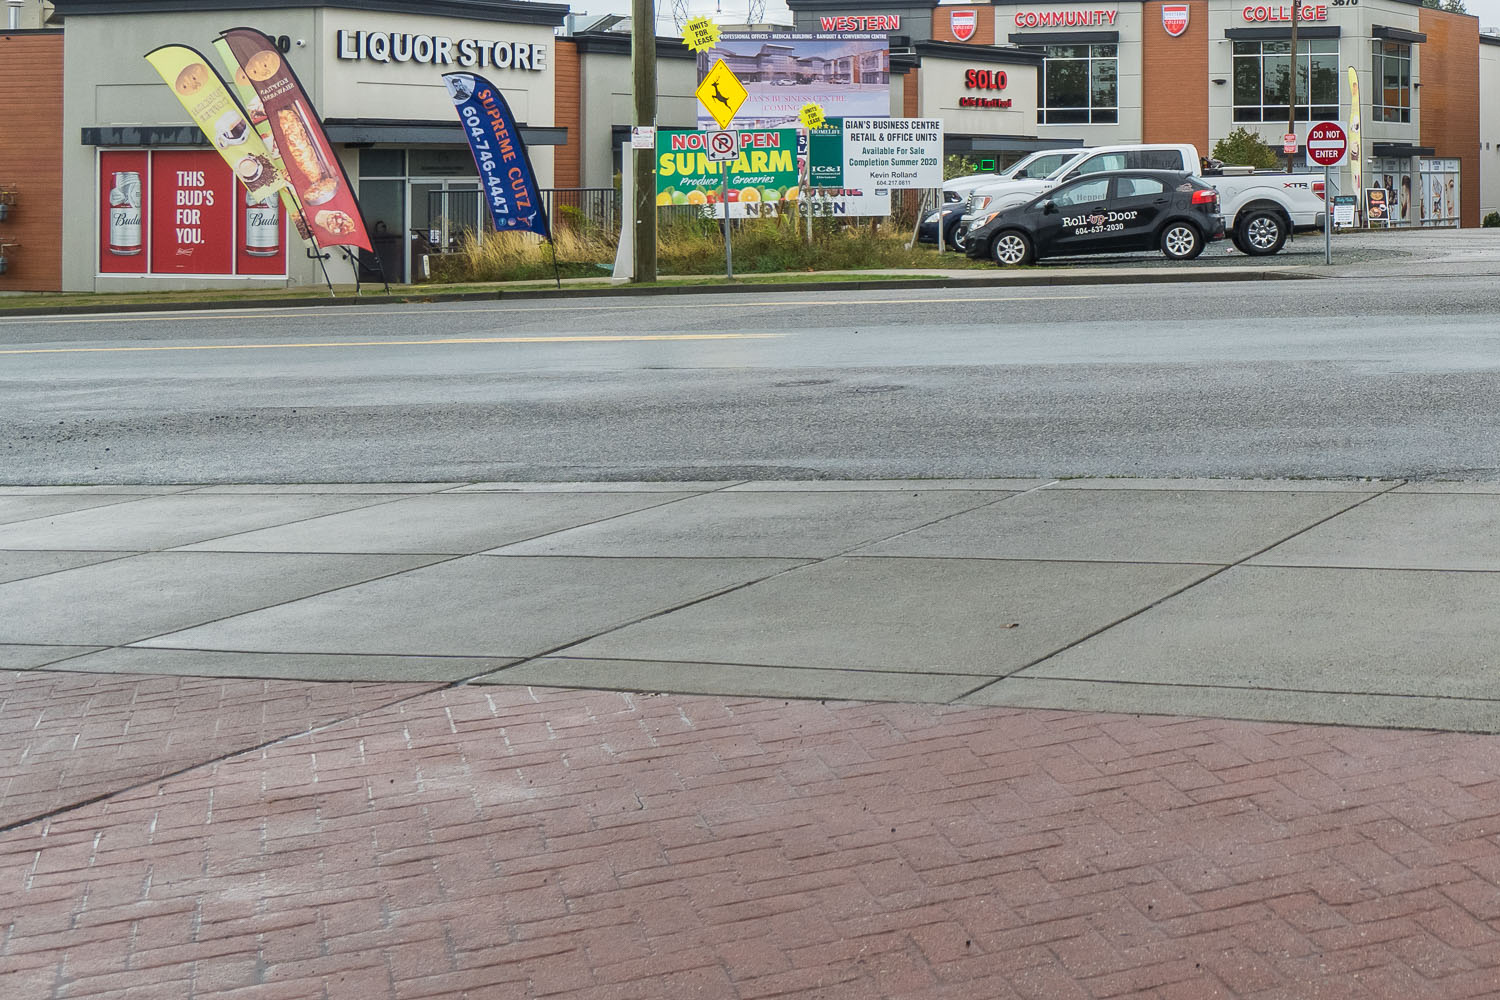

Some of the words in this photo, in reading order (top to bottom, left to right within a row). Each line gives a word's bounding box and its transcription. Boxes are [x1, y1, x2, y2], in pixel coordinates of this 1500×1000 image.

[1014, 10, 1118, 28] COMMUNITY
[1243, 5, 1328, 22] COLLEGE
[690, 21, 709, 31] UNITS
[820, 15, 901, 31] WESTERN
[694, 29, 709, 38] FOR
[694, 35, 714, 46] LEASE
[337, 29, 454, 64] LIQUOR
[457, 39, 547, 71] STORE
[965, 69, 1008, 90] SOLO
[845, 120, 871, 130] GIAN'S
[872, 120, 909, 130] BUSINESS
[911, 120, 940, 130] CENTRE
[672, 134, 708, 151] NO
[740, 132, 781, 149] PEN
[850, 132, 876, 142] RETAIL
[878, 132, 885, 142] &
[886, 132, 913, 142] OFFICE
[915, 132, 938, 142] UNITS
[1313, 131, 1324, 139] DO
[1326, 131, 1340, 139] NOT
[477, 89, 516, 163] SUPREME
[508, 167, 532, 211] CUTZ
[862, 146, 894, 155] Available
[896, 146, 908, 155] For
[909, 146, 925, 155] Sale
[1315, 150, 1339, 158] ENTER
[462, 106, 509, 214] 604-746-4447
[849, 158, 889, 167] Completion
[890, 158, 919, 166] Summer
[920, 158, 938, 166] 2020
[811, 165, 841, 173] IC&I
[176, 171, 205, 187] THIS
[680, 174, 718, 186] Produce
[733, 174, 775, 185] Groceries
[176, 190, 214, 206] BUD'S
[176, 209, 201, 225] FOR
[1062, 211, 1137, 228] Roll-up-Door
[176, 228, 205, 244] YOU.
[1075, 223, 1124, 235] 604-637-2030
